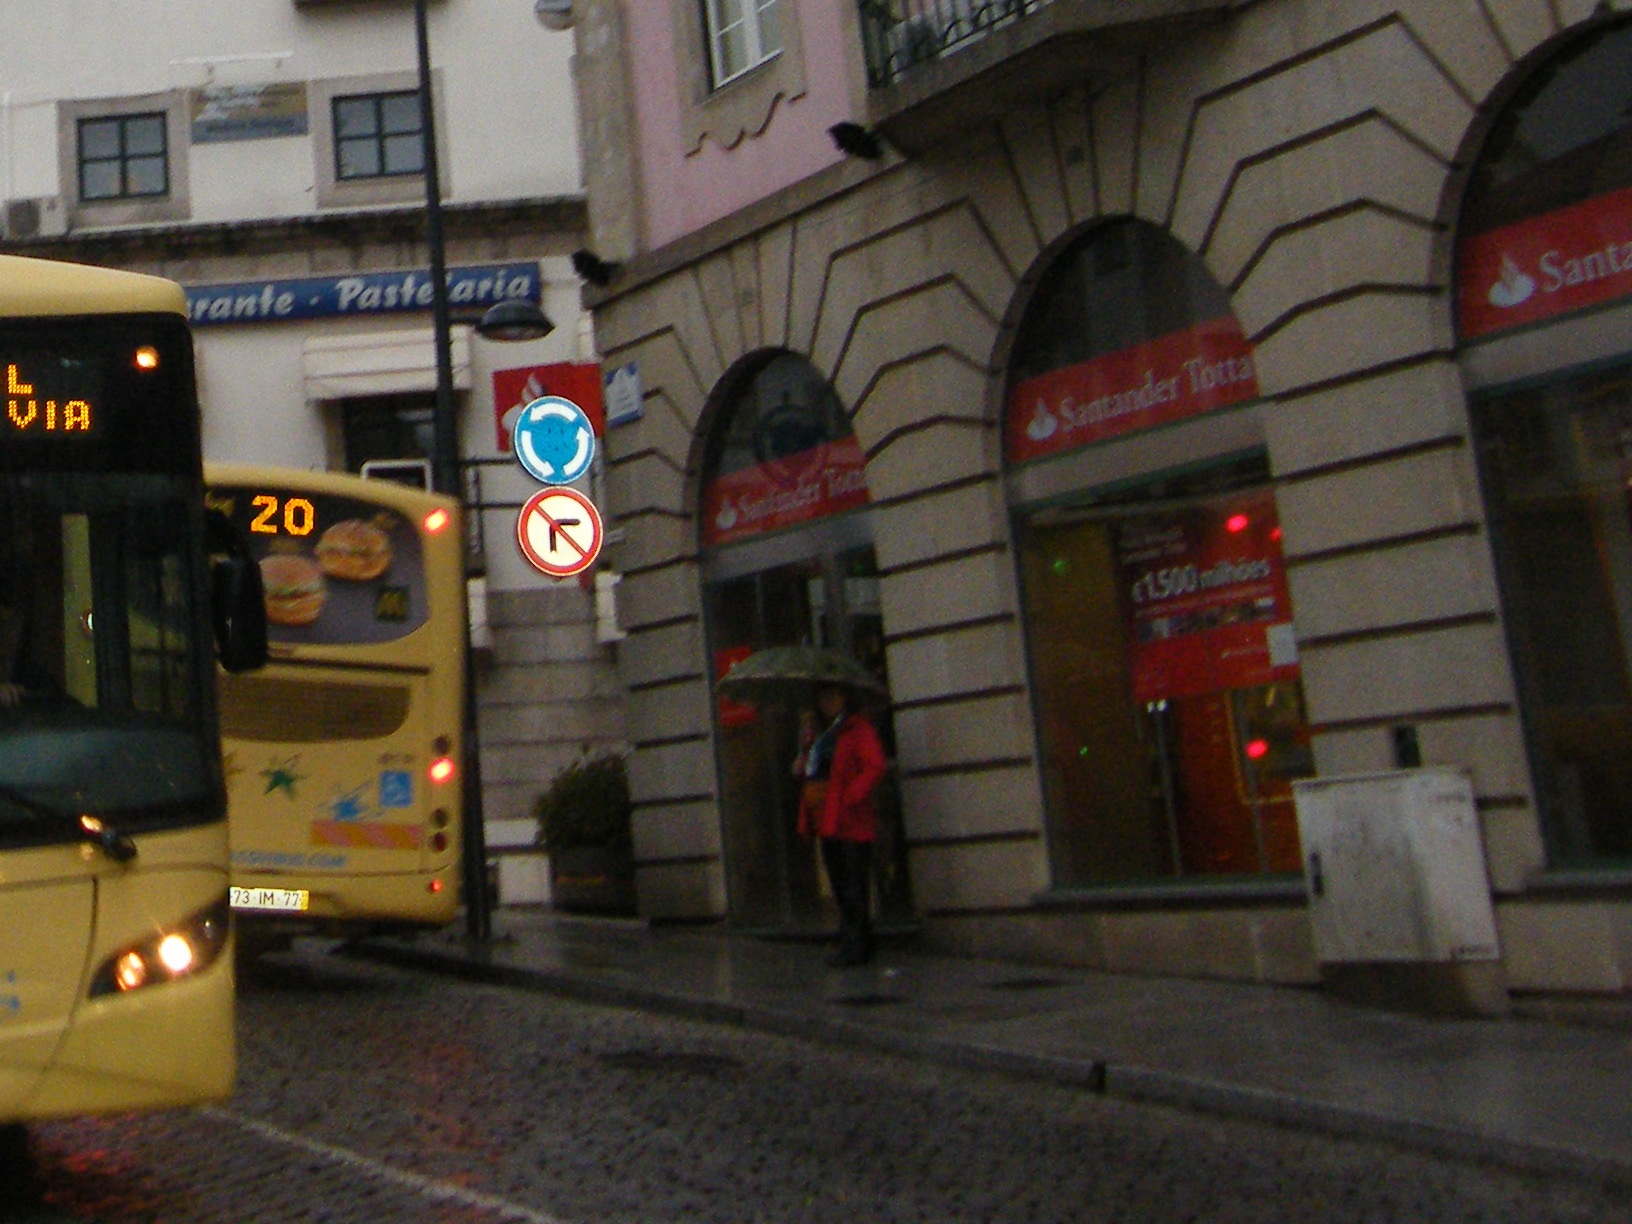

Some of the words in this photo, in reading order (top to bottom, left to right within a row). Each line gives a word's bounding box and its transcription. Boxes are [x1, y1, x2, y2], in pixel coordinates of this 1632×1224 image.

[188, 284, 295, 320] rante
[335, 269, 531, 311] Pastearia
[8, 400, 91, 431] VIA
[1059, 368, 1182, 433] Santander
[250, 495, 315, 536] 20
